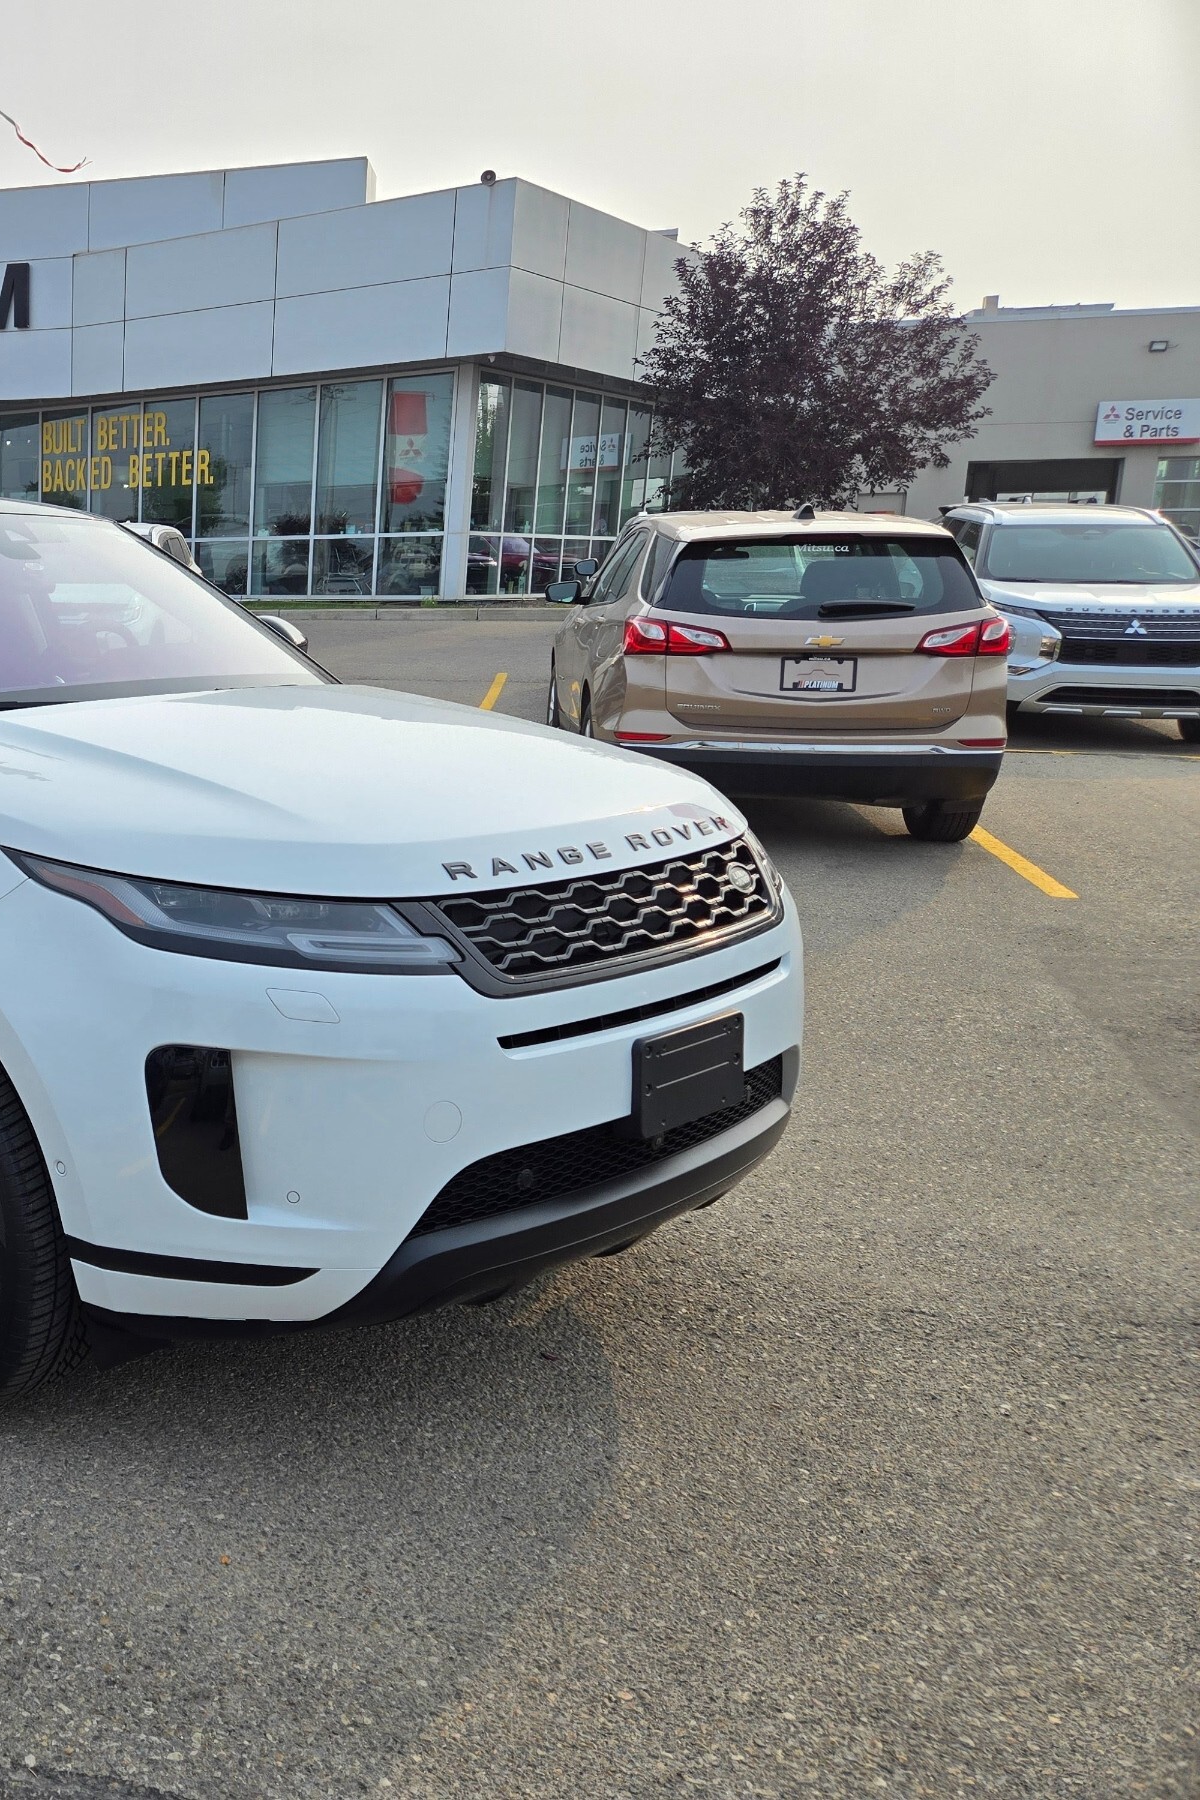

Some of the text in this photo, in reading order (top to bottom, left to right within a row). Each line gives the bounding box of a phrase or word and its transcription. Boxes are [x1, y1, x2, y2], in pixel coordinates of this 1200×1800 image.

[1124, 406, 1182, 421] Service
[42, 411, 171, 455] BUILT BETTER.
[1123, 424, 1179, 438] & Parts
[42, 449, 214, 493] BACKED BETTER.
[803, 680, 839, 689] PLATINUM
[442, 816, 728, 881] RANGE ROVER
